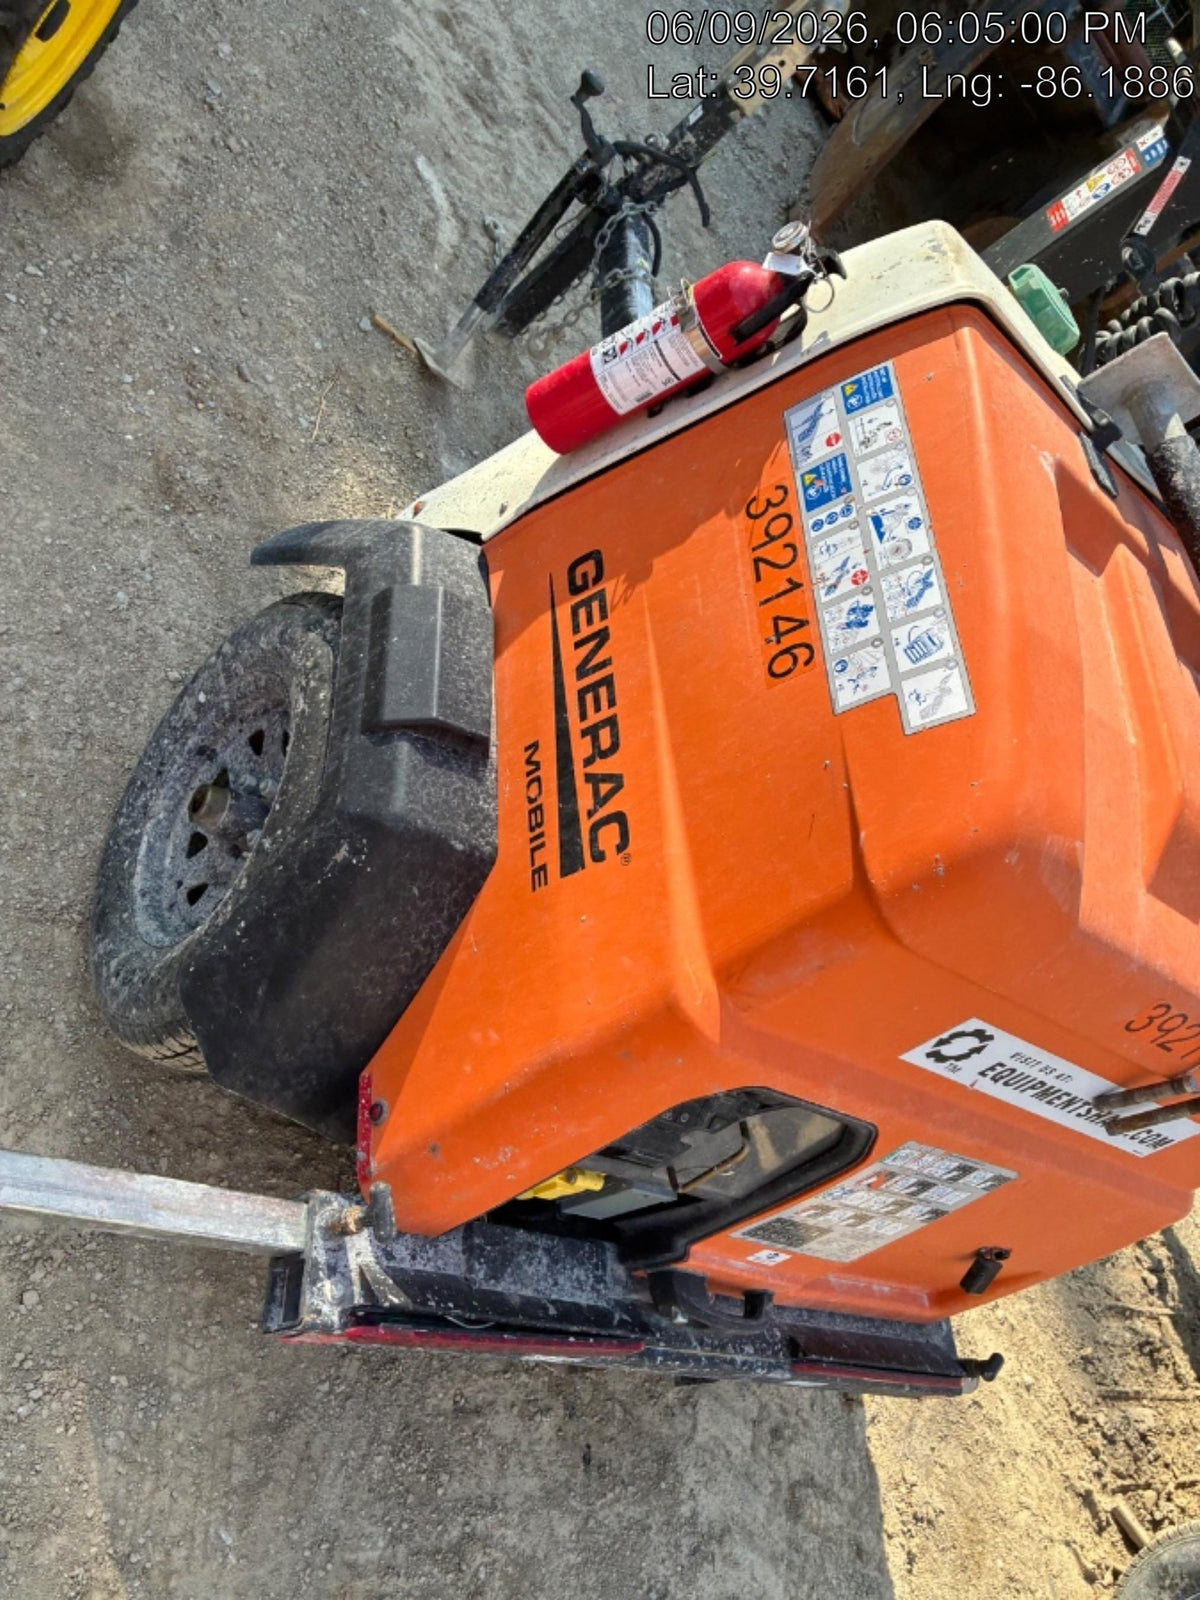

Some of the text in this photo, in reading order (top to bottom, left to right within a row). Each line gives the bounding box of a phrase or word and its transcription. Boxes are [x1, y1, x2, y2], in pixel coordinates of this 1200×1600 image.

[745, 484, 815, 679] 392146
[523, 739, 548, 893] MOBILE
[977, 1061, 1175, 1150] EQUIPMENTSHA.COM
